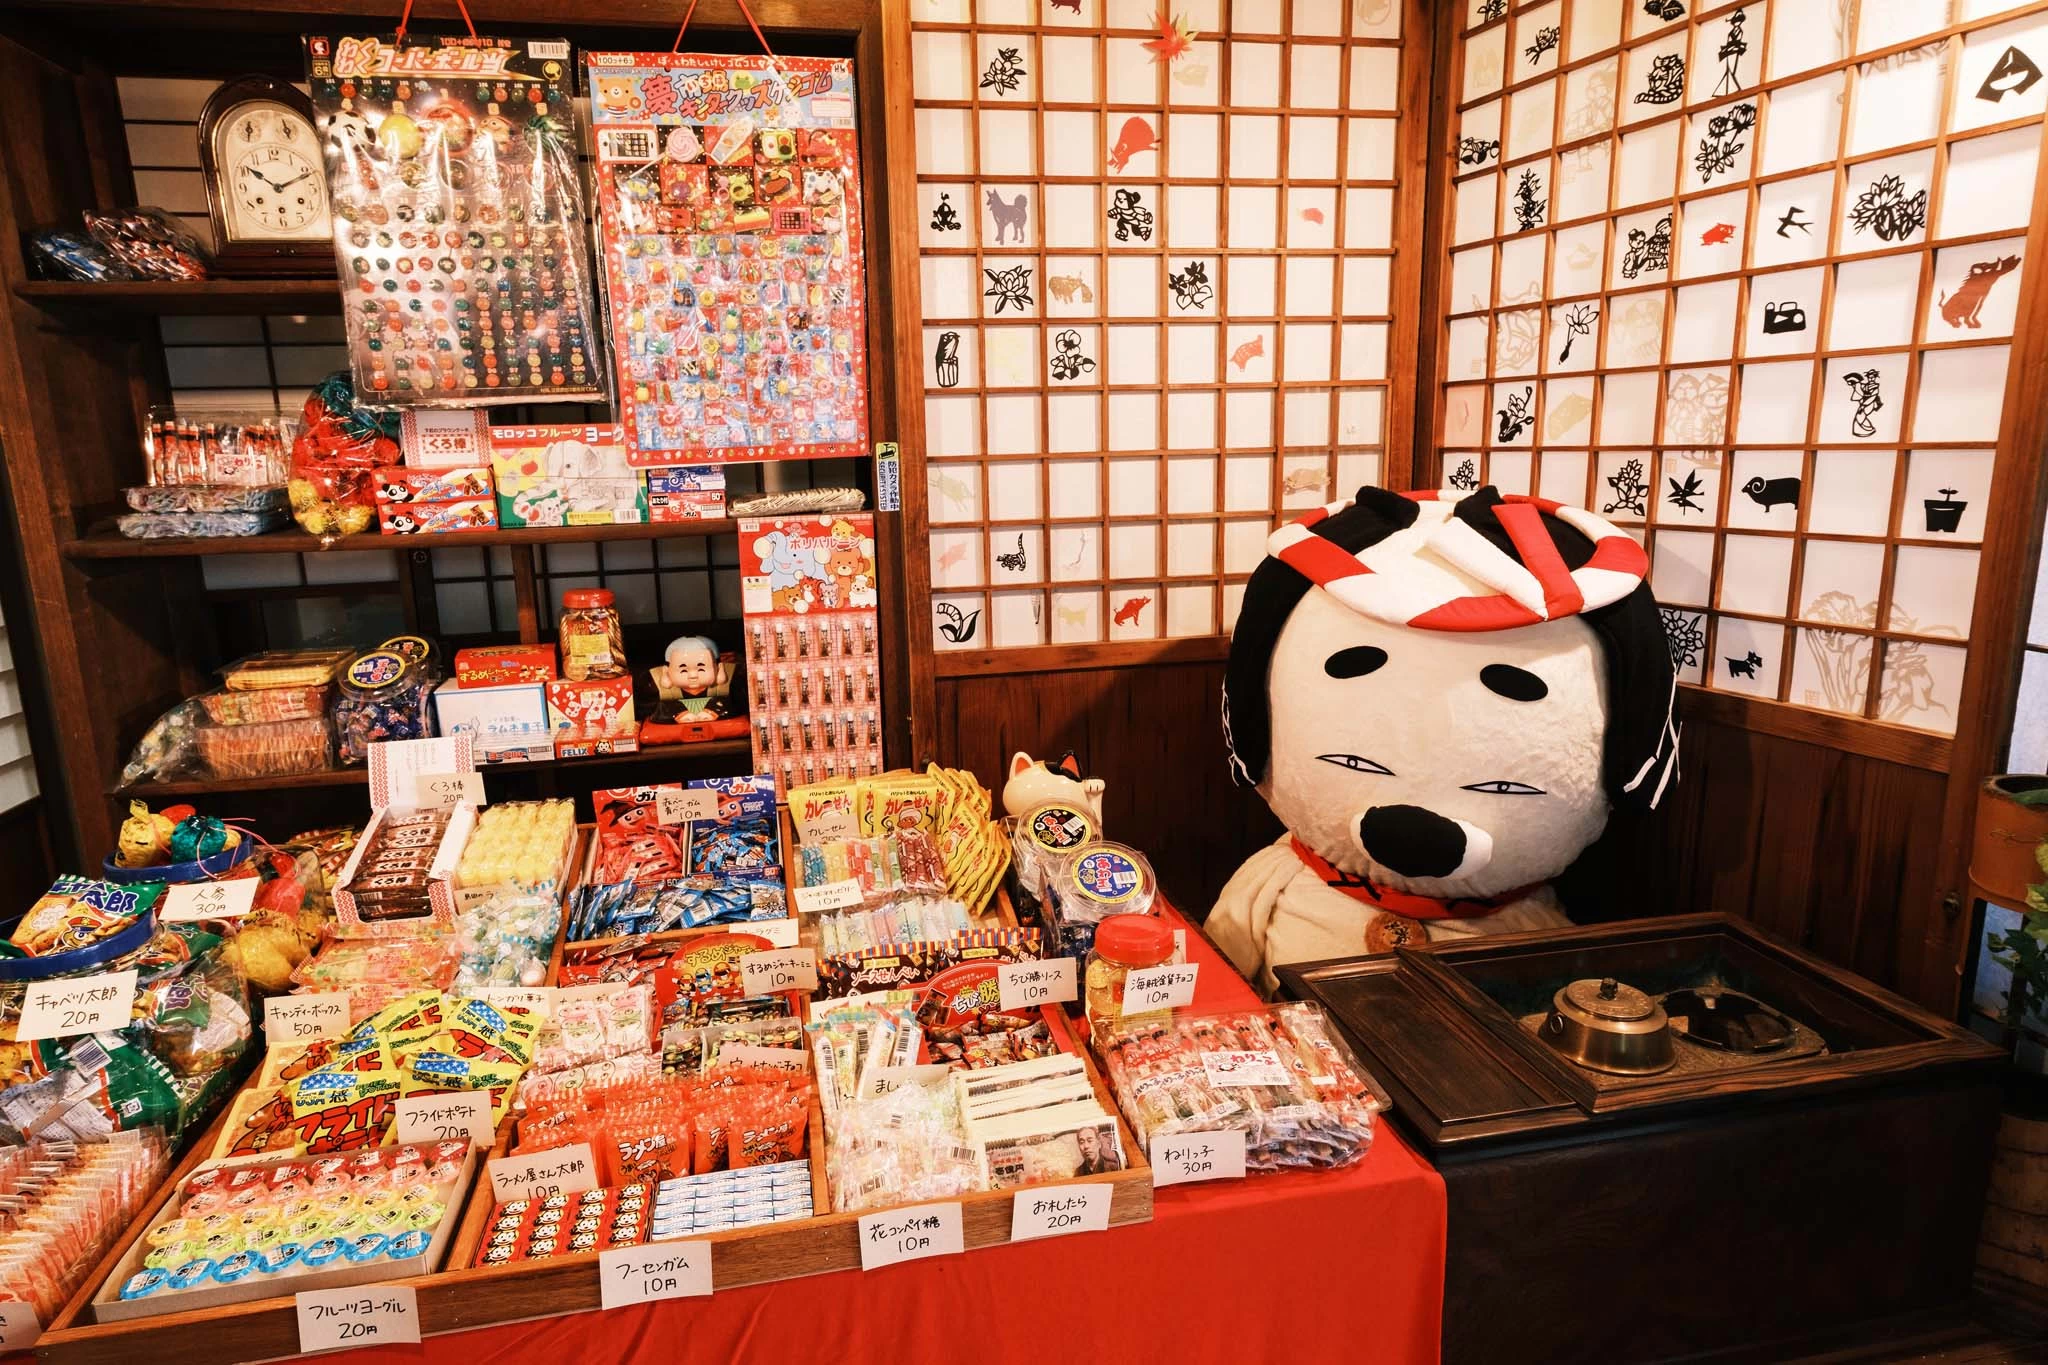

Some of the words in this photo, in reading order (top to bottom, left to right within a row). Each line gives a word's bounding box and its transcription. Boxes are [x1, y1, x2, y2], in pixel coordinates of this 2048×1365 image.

[279, 216, 288, 228] 6
[887, 461, 899, 510] 防犯カメラ作動中
[789, 536, 862, 551] ポリバルーン
[561, 748, 588, 757] FELIX
[430, 780, 465, 793] くろ棒
[730, 783, 756, 794] ガム
[443, 793, 465, 803] 20円
[884, 795, 933, 817] カレーせん
[804, 795, 853, 820] カレーせん
[807, 824, 847, 837] カレーせん
[194, 904, 227, 915] 30円
[745, 959, 812, 976] するめジャーキーミニ
[850, 966, 921, 986] ソースせんべい
[770, 973, 795, 987] 10円
[1130, 973, 1194, 992] 海賊金貨チョコ
[36, 986, 118, 1009] キャベツ太郎
[1023, 986, 1048, 1001] 10円
[1146, 991, 1169, 1005] 10円
[60, 1009, 101, 1029] 20円
[270, 1004, 342, 1020] キャンディーボックス
[293, 1023, 323, 1036] 50円
[294, 1091, 401, 1142] フライド
[405, 1105, 477, 1127] フライドポテト
[618, 1133, 667, 1161] ラーメン屋
[1163, 1144, 1215, 1162] ねりっ子
[496, 1160, 586, 1189] ラーメン屋さん太郎
[1182, 1161, 1212, 1176] 30円
[527, 1184, 560, 1200] 10円
[869, 1215, 941, 1242] 花コンペイ糖
[1047, 1214, 1082, 1229] 20円
[897, 1236, 930, 1253] 10円
[615, 1256, 690, 1280] フーセンガム
[643, 1277, 678, 1295] 10円
[308, 1299, 407, 1320] フルーツヨーグル
[338, 1323, 378, 1340] 20円
